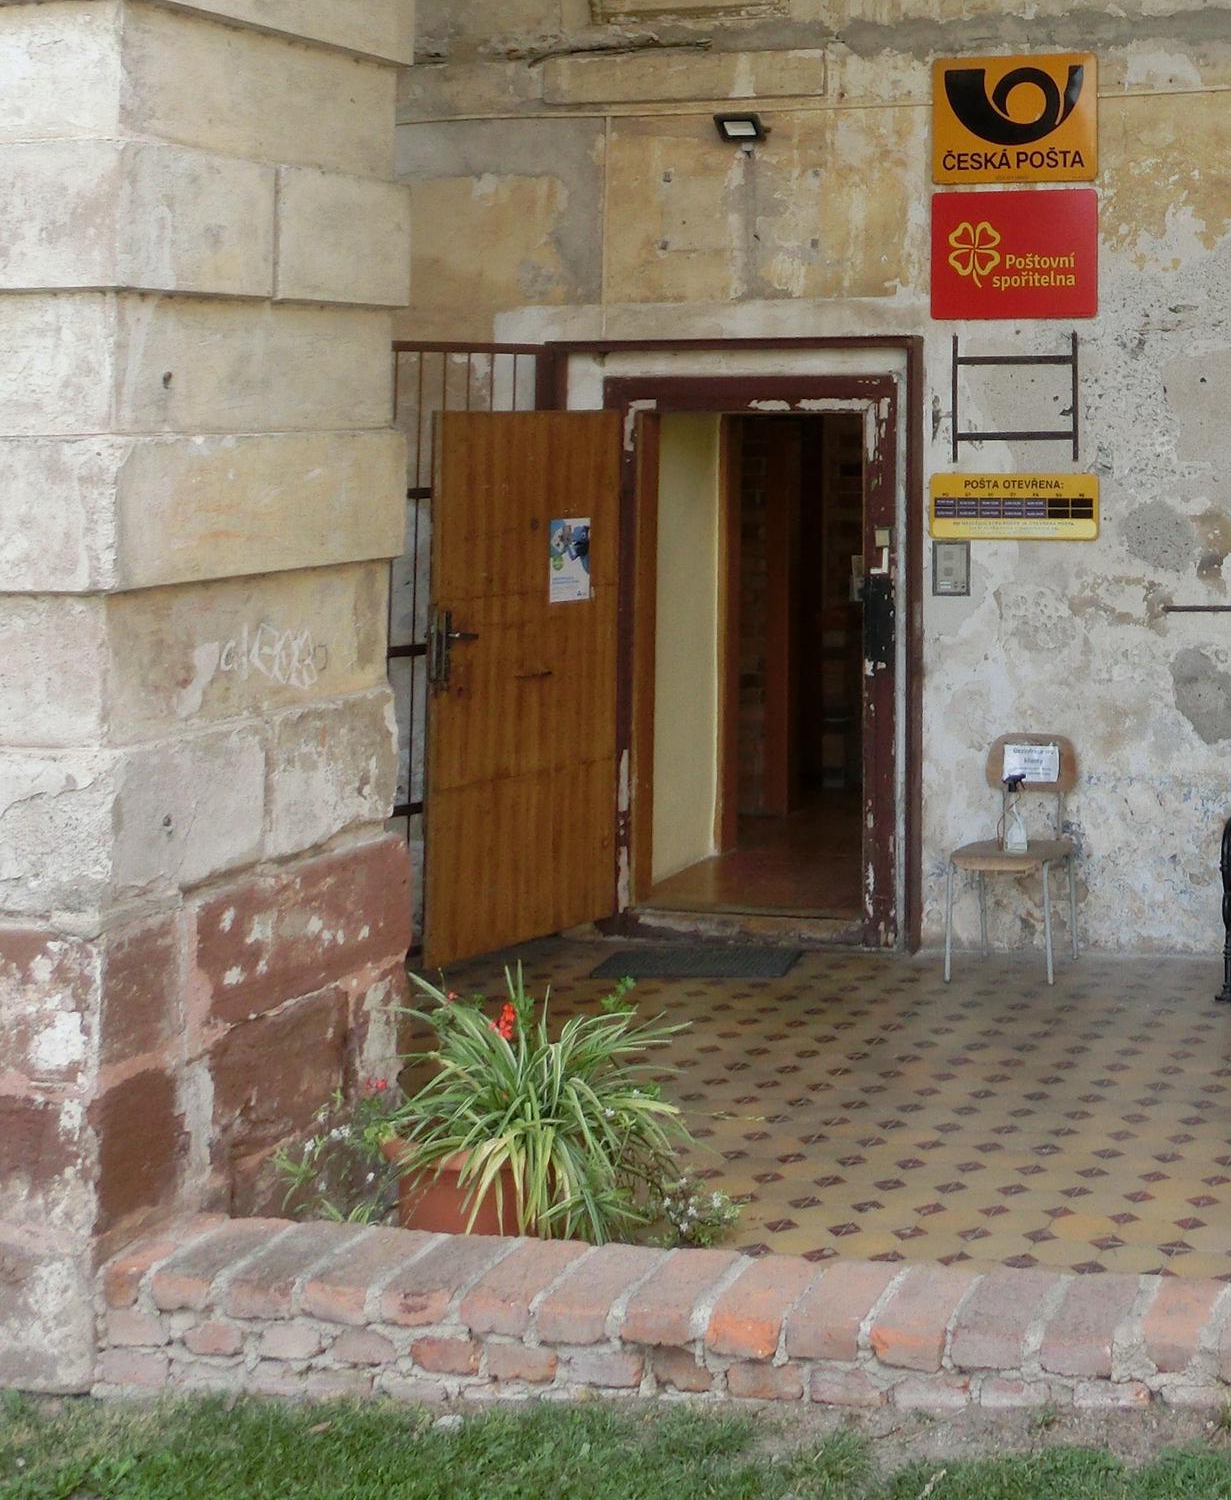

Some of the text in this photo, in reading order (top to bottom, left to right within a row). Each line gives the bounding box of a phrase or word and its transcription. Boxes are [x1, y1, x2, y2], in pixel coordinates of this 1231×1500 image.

[942, 147, 1085, 171] ČESKÁ POŠTA
[1005, 252, 1076, 269] Poštovní
[992, 271, 1076, 291] spořitelna
[964, 477, 1064, 489] POŠTA OTEVŘENA:
